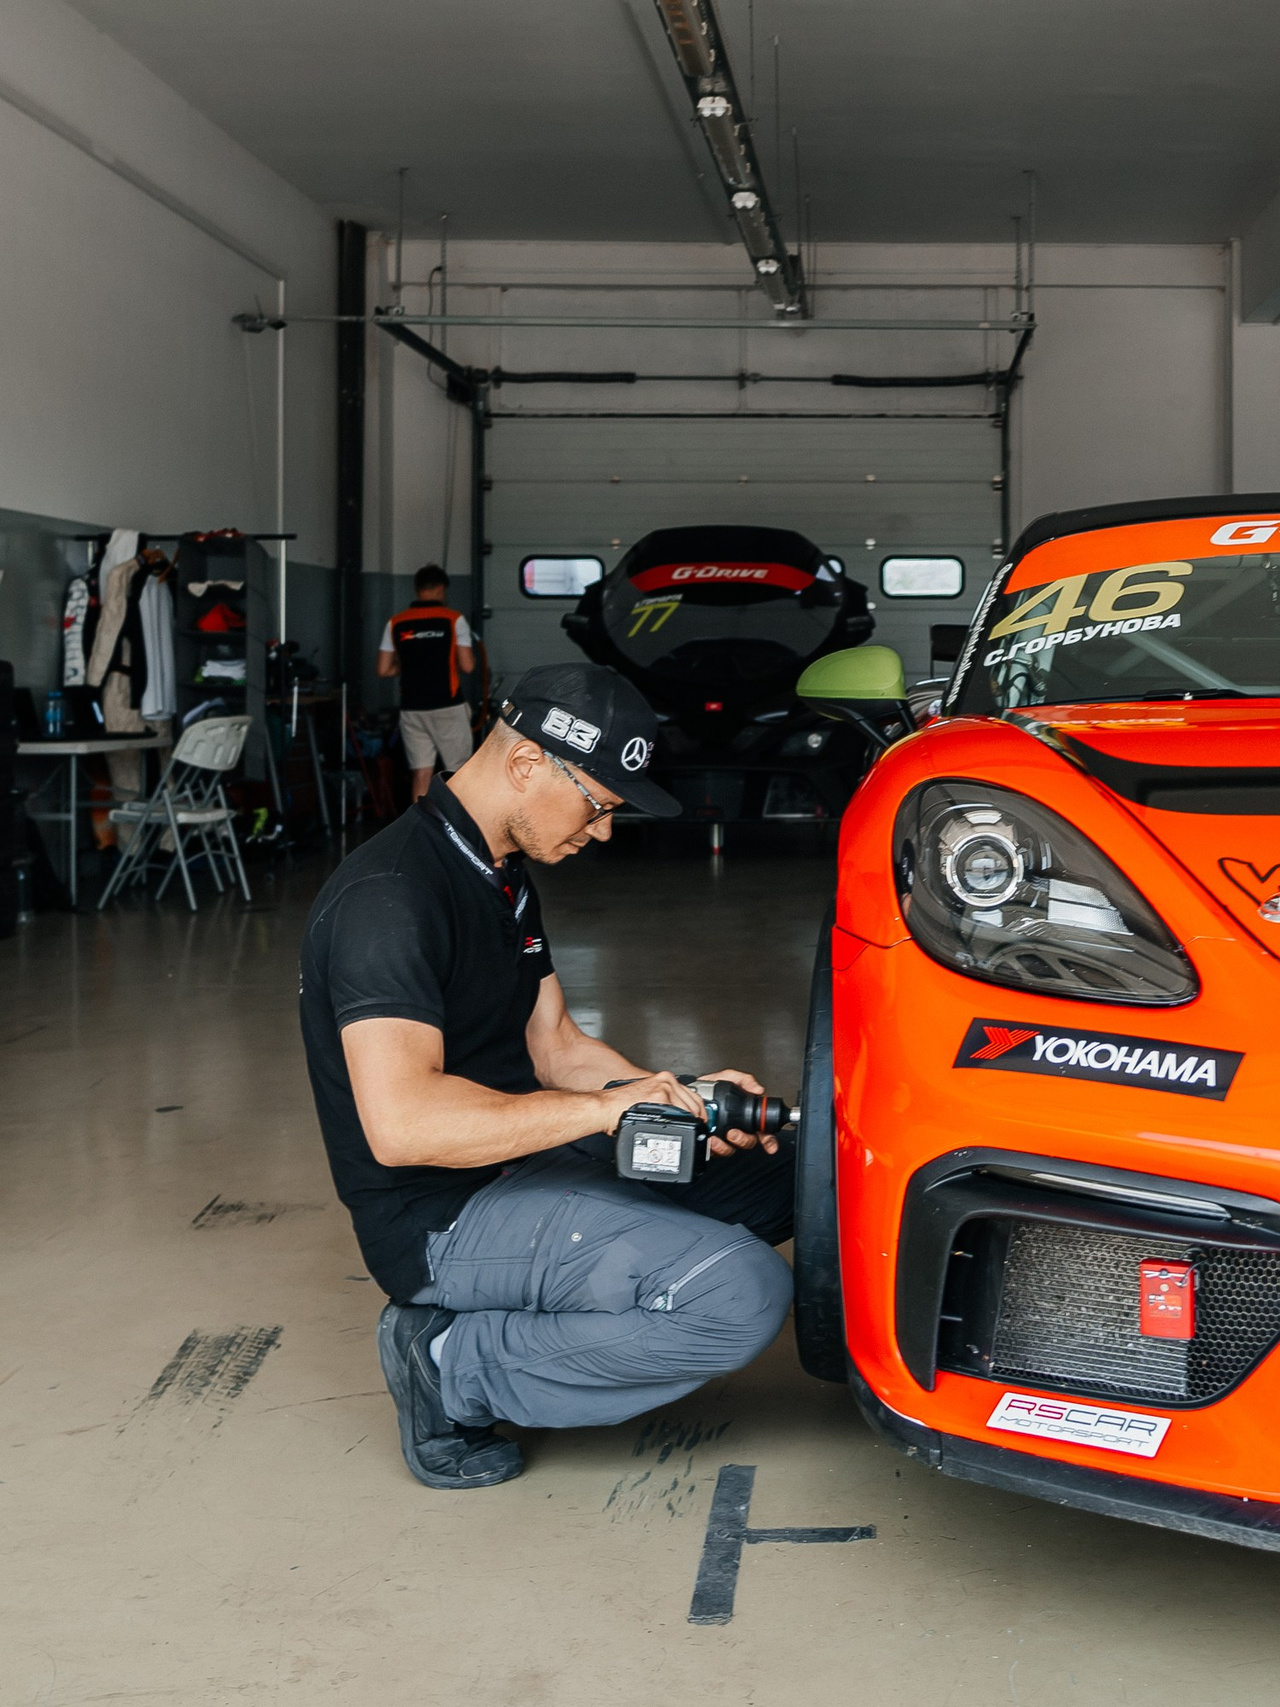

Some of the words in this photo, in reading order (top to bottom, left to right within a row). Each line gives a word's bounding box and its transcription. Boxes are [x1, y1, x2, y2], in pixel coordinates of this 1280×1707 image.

[627, 602, 680, 637] 77
[988, 561, 1194, 641] 46
[984, 613, 1182, 667] С.ГОРБУНОВА
[1032, 1034, 1217, 1087] YOKOHAMA
[998, 1415, 1149, 1448] MOTORSPORT
[1005, 1399, 1158, 1437] RSCAR
